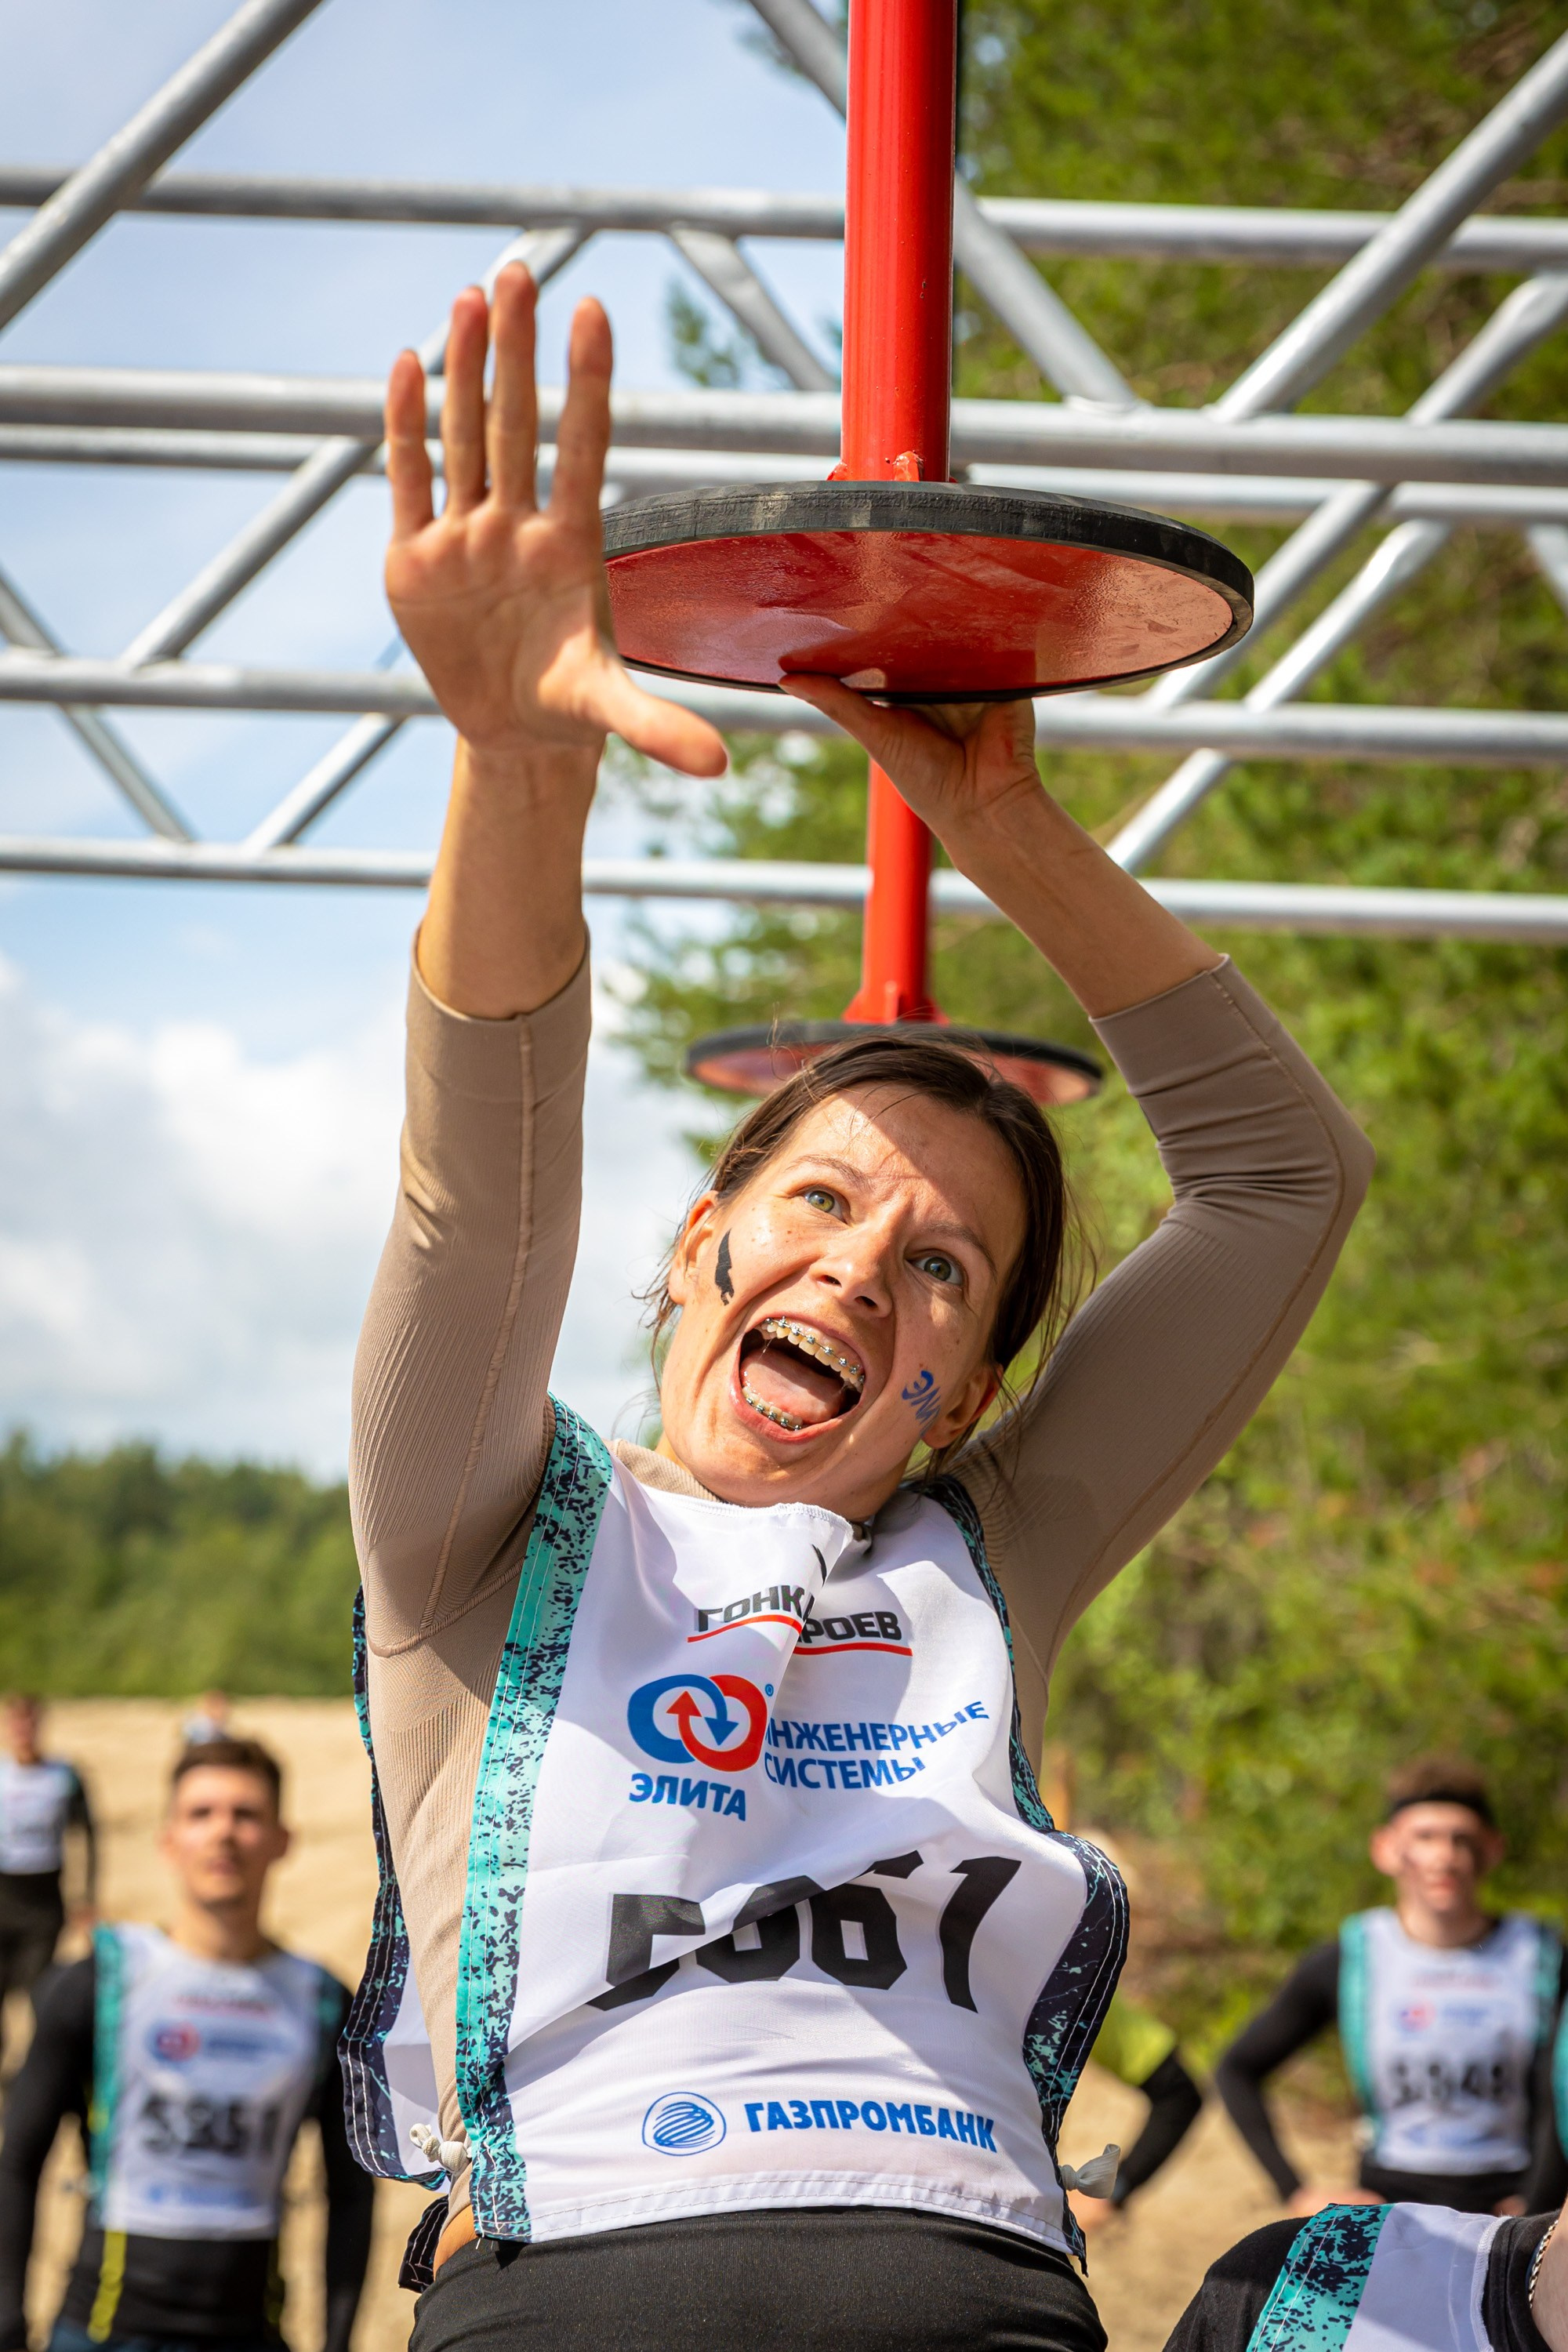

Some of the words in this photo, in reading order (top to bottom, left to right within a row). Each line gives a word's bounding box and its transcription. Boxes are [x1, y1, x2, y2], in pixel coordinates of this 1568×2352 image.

[798, 1611, 902, 1644] РОЕВ
[764, 1750, 926, 1789] СИСТЕМЫ
[629, 1773, 746, 1821] ЭЛИТА
[744, 2100, 996, 2153] ГАЗПРОМБАНК
